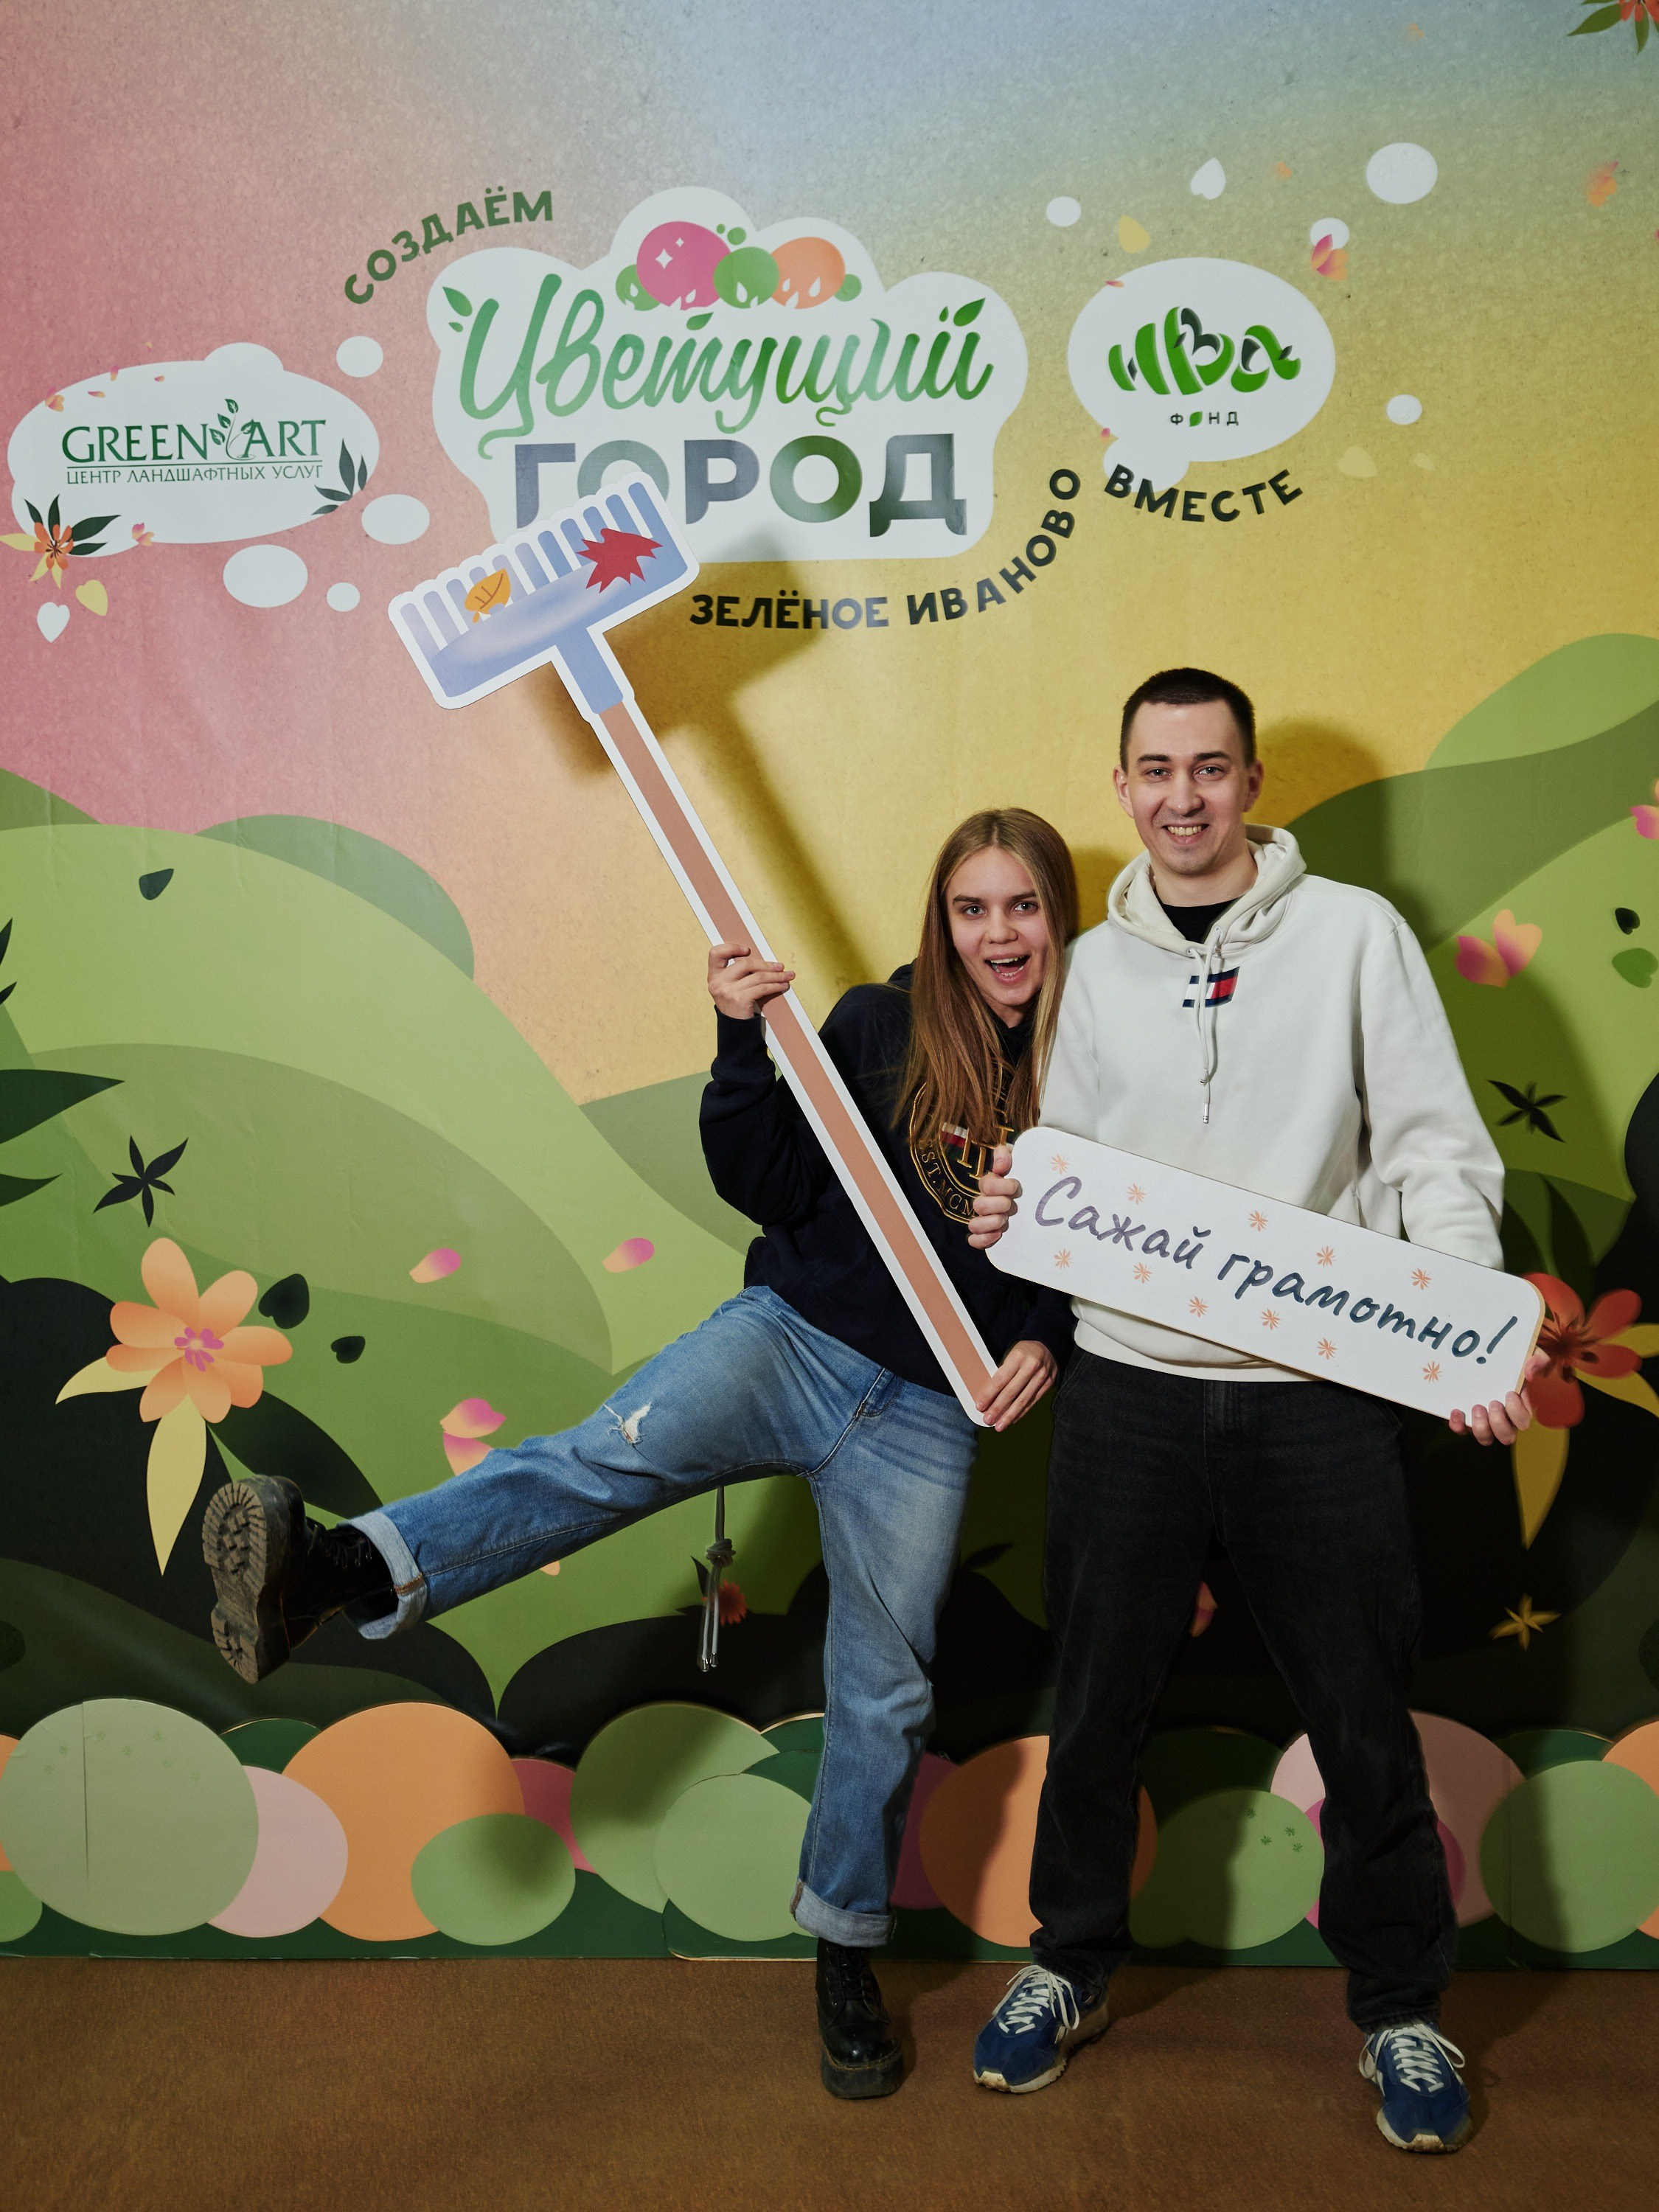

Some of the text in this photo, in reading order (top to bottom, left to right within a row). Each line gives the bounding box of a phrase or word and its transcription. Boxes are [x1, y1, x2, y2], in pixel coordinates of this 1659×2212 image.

[344, 185, 554, 305] СОЗДАЁМ
[457, 272, 995, 460] Цветущий
[62, 419, 327, 463] GREEN ART
[66, 465, 324, 484] ЦЕНТР ЛАНДШАФТНЫХ УСЛУГ
[690, 465, 1304, 630] ЗЕЛЁНОЕ ИВАНОВО ВМЕСТЕ
[1034, 1175, 1518, 1365] Сажай грамотно!
